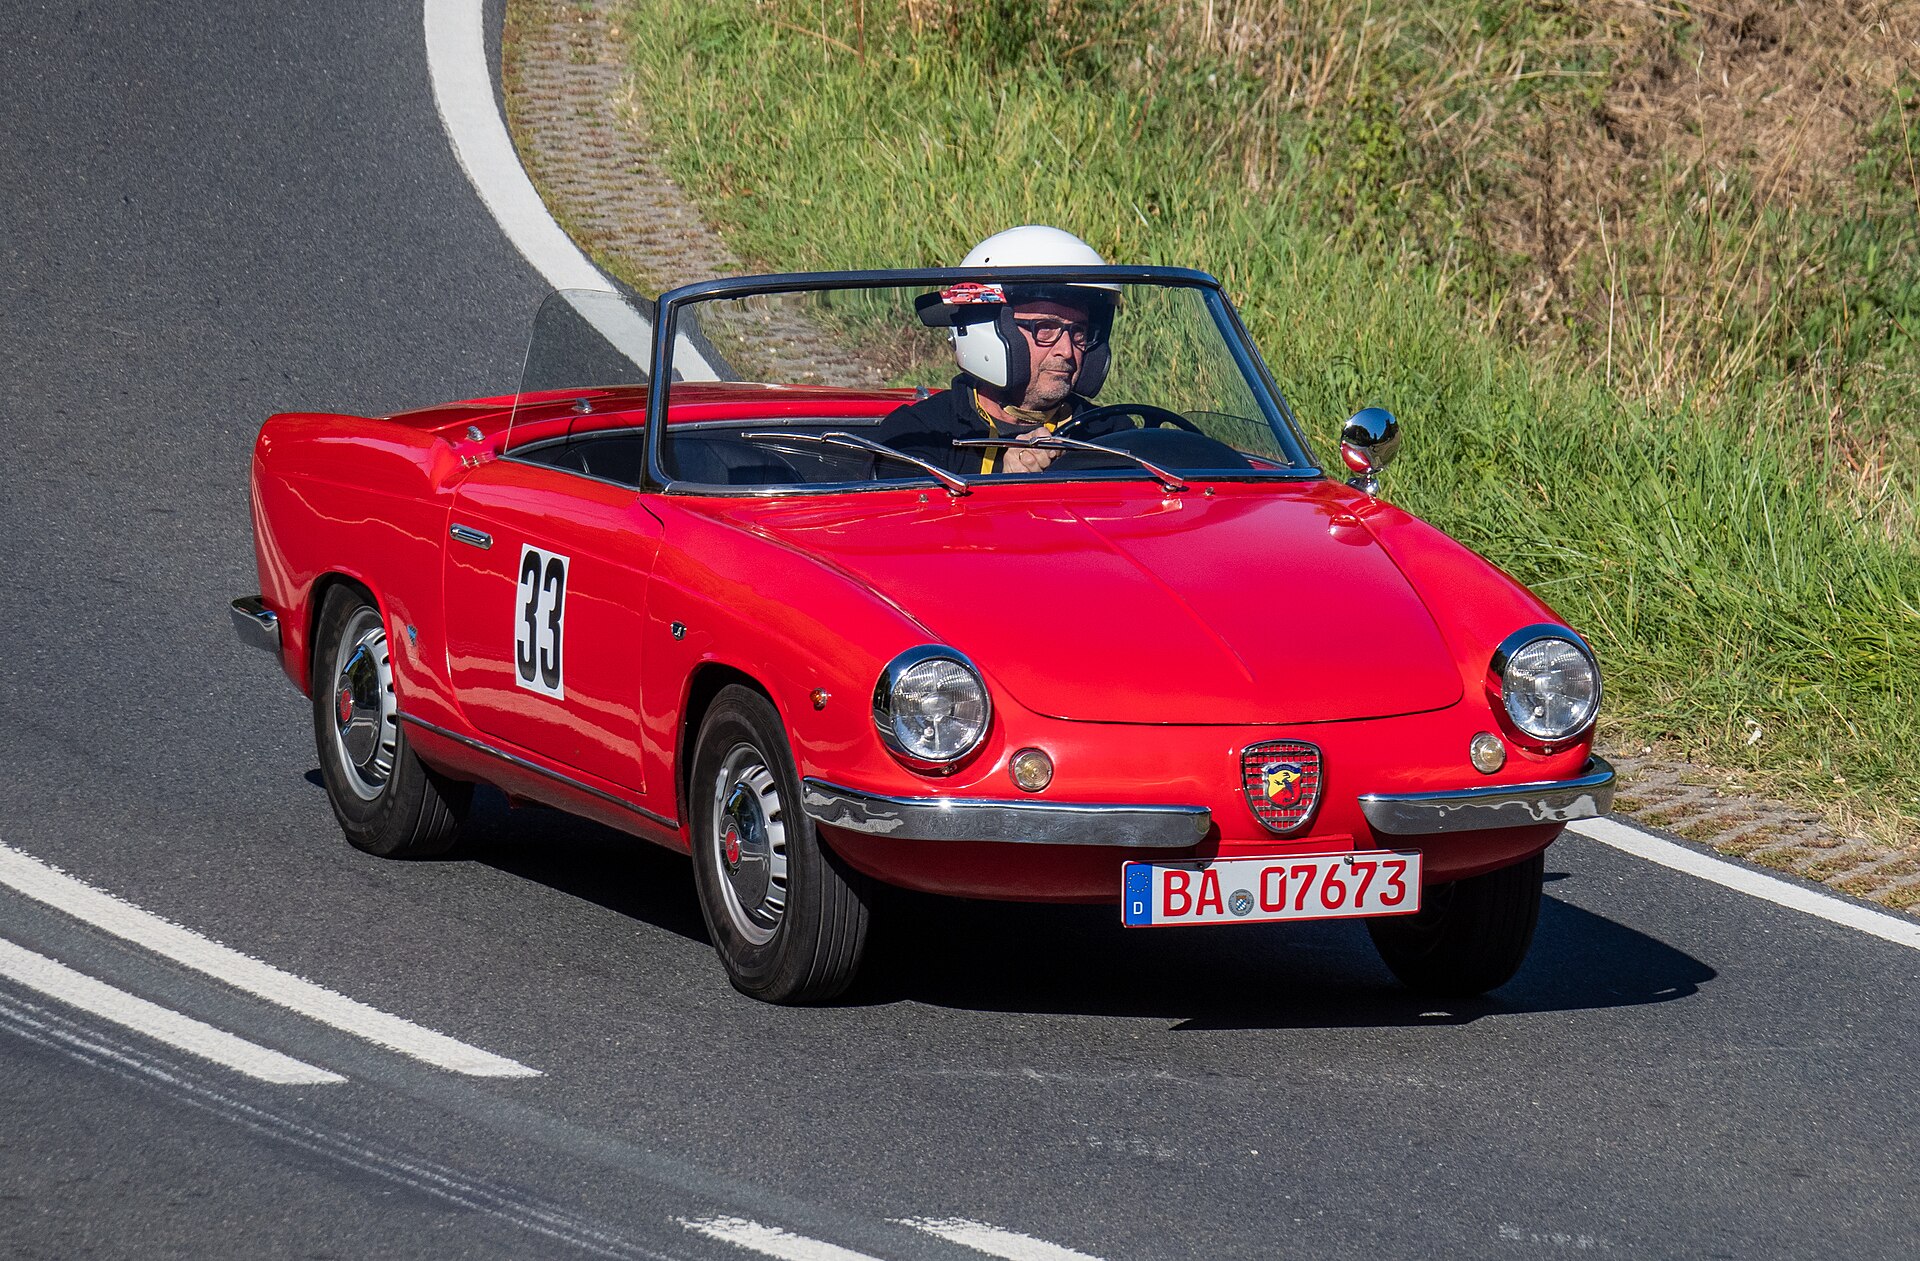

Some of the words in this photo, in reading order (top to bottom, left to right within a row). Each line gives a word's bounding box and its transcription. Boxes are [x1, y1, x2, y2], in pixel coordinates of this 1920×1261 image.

[517, 549, 565, 690] 33
[1133, 901, 1143, 915] D
[1163, 869, 1224, 917] BA
[1260, 860, 1407, 912] 07673
